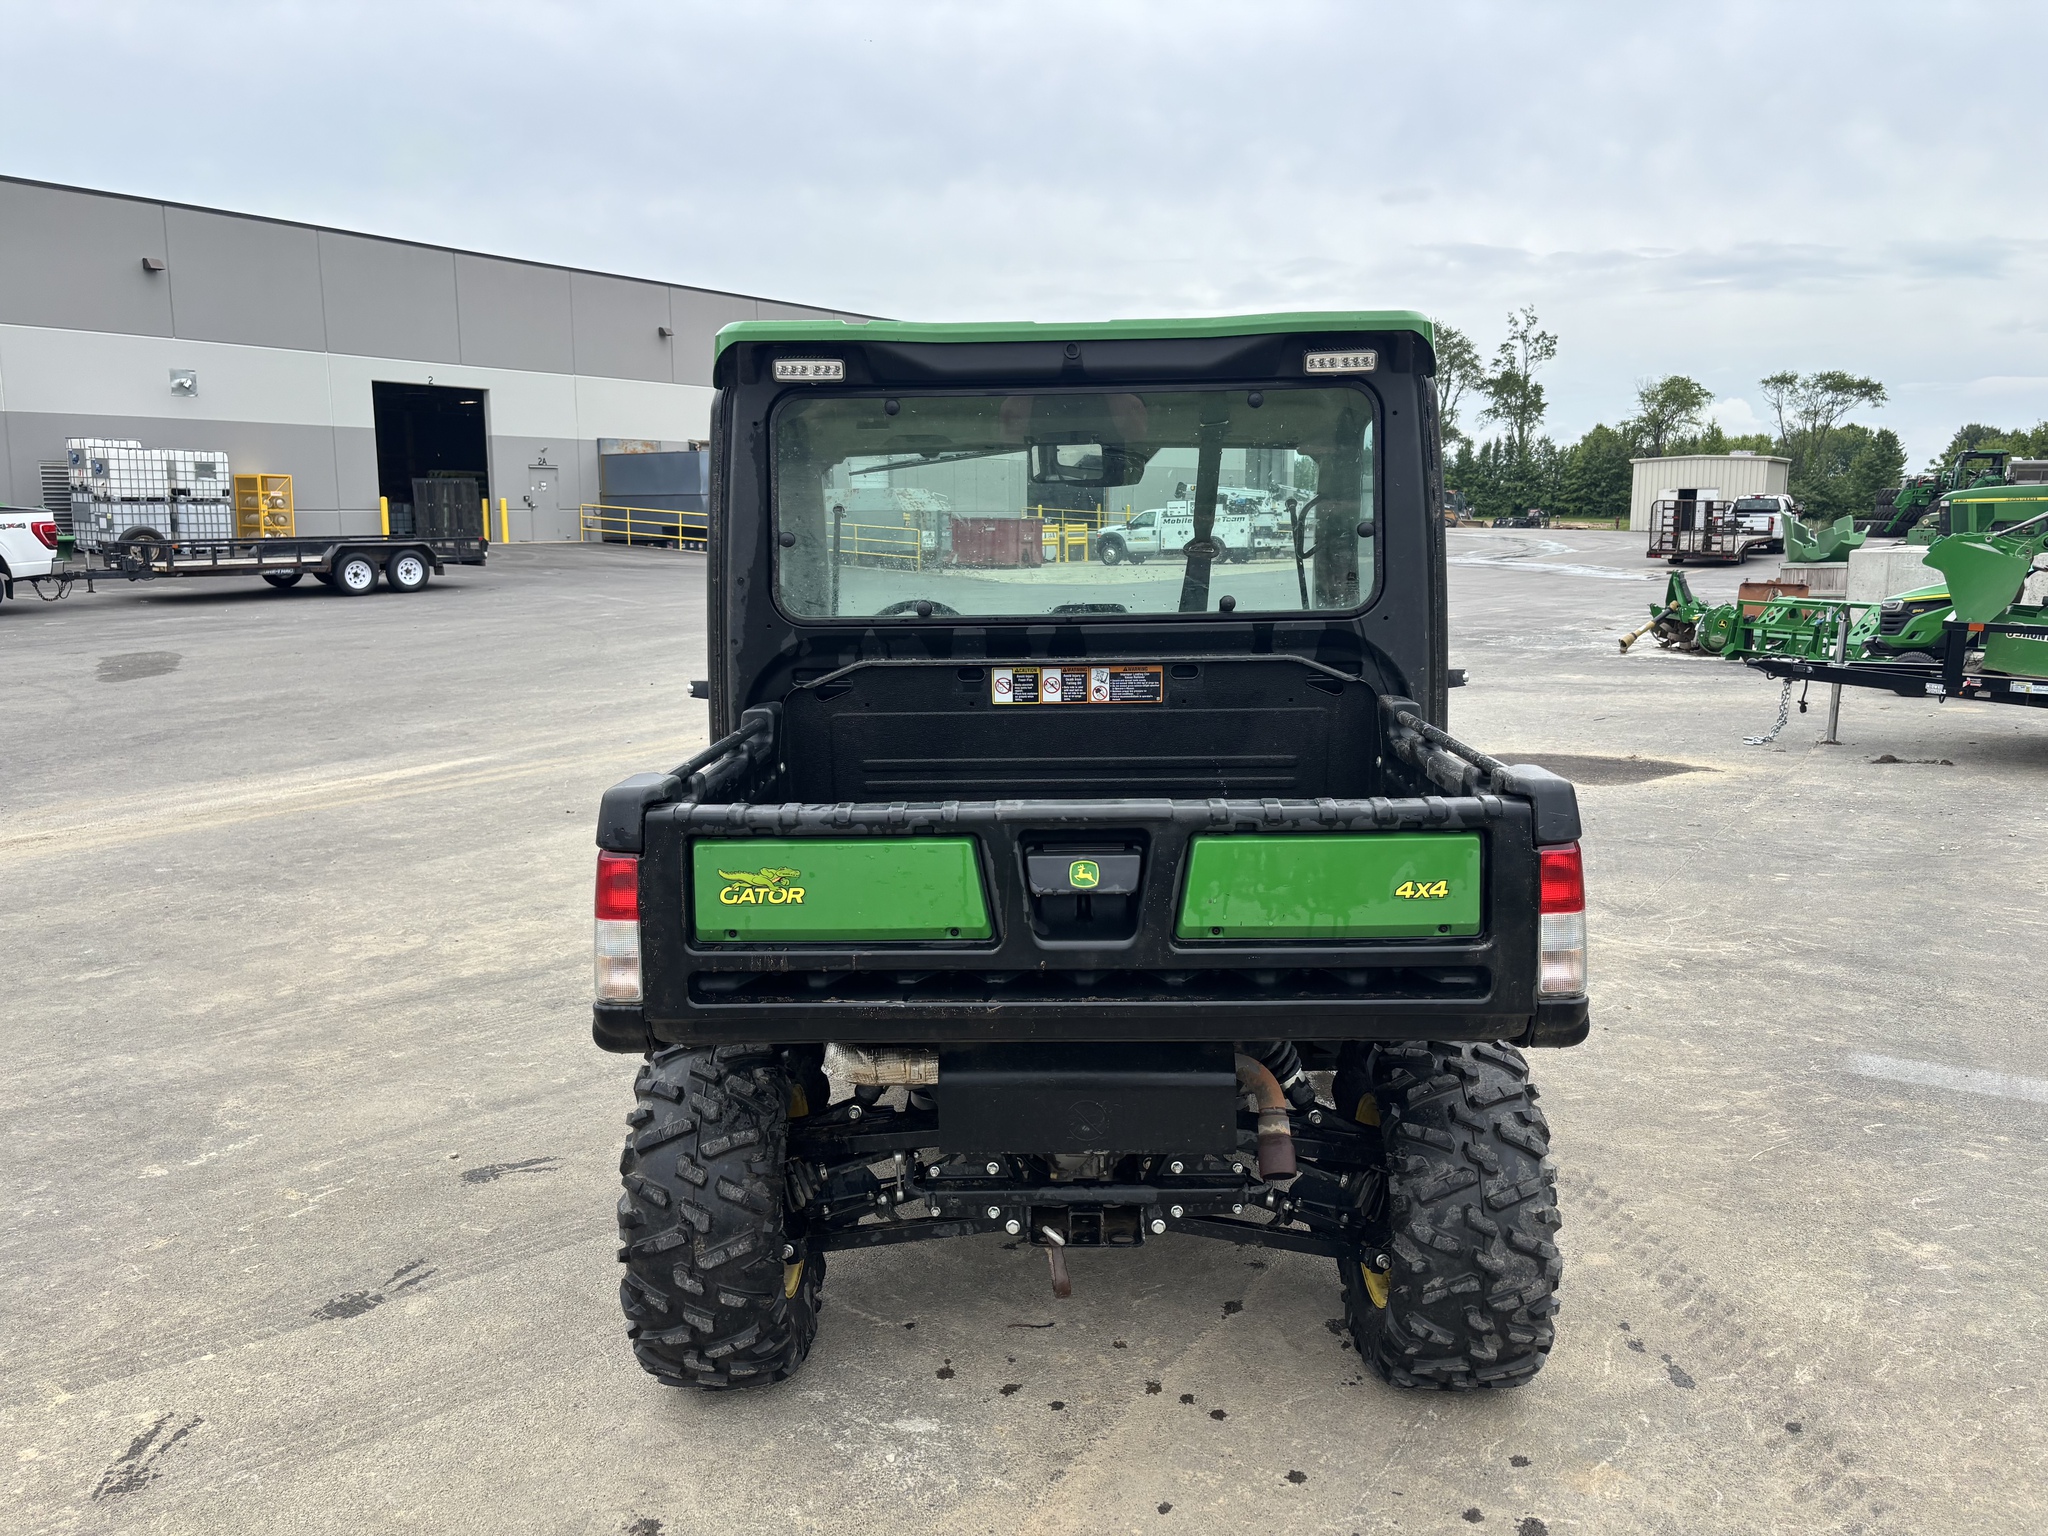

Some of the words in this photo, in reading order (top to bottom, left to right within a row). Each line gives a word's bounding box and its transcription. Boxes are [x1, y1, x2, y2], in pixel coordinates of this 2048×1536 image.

[428, 375, 434, 385] 2
[537, 456, 548, 466] 2A
[1162, 517, 1193, 525] Mobile
[1222, 515, 1246, 523] Team
[1394, 880, 1449, 899] 4x4
[719, 886, 805, 904] GATOR
